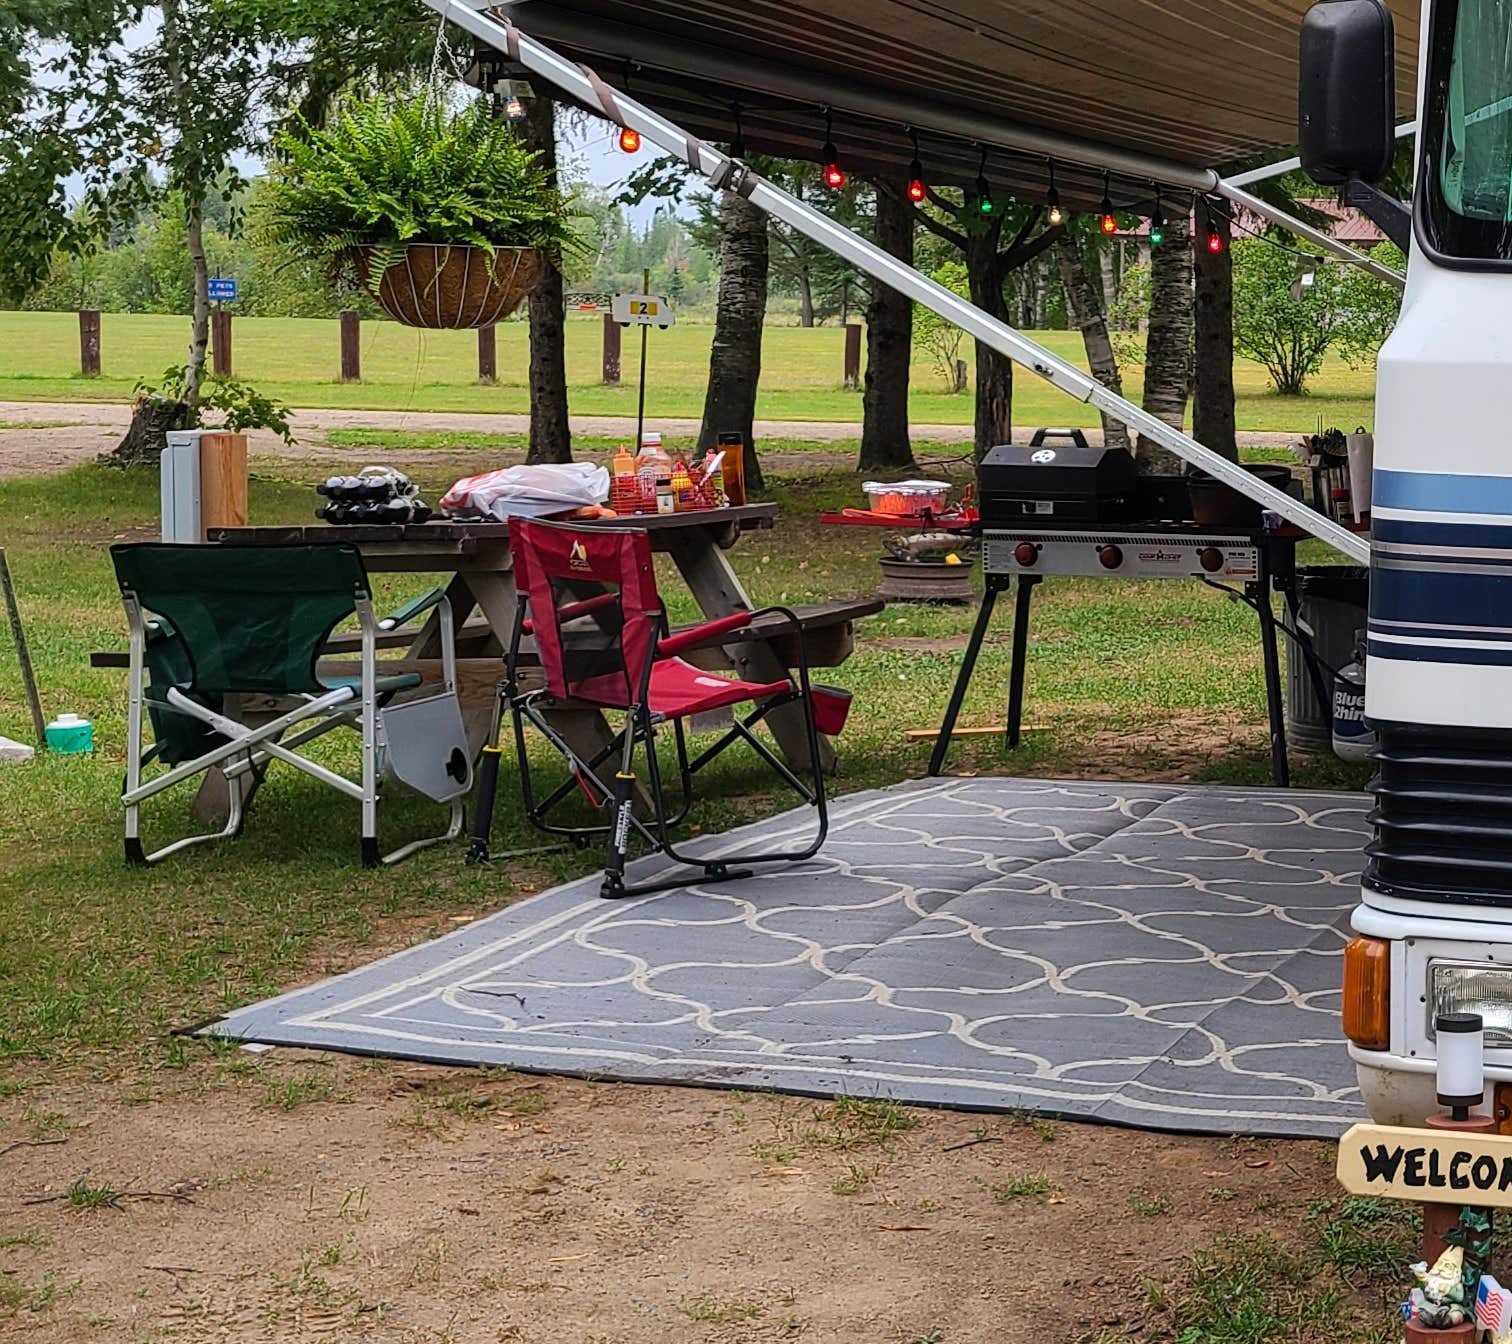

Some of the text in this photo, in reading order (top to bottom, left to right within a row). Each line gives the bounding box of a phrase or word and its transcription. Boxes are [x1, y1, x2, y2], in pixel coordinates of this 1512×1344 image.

[640, 302, 648, 315] 2
[1335, 691, 1366, 707] Blue
[1334, 706, 1364, 721] Rhin
